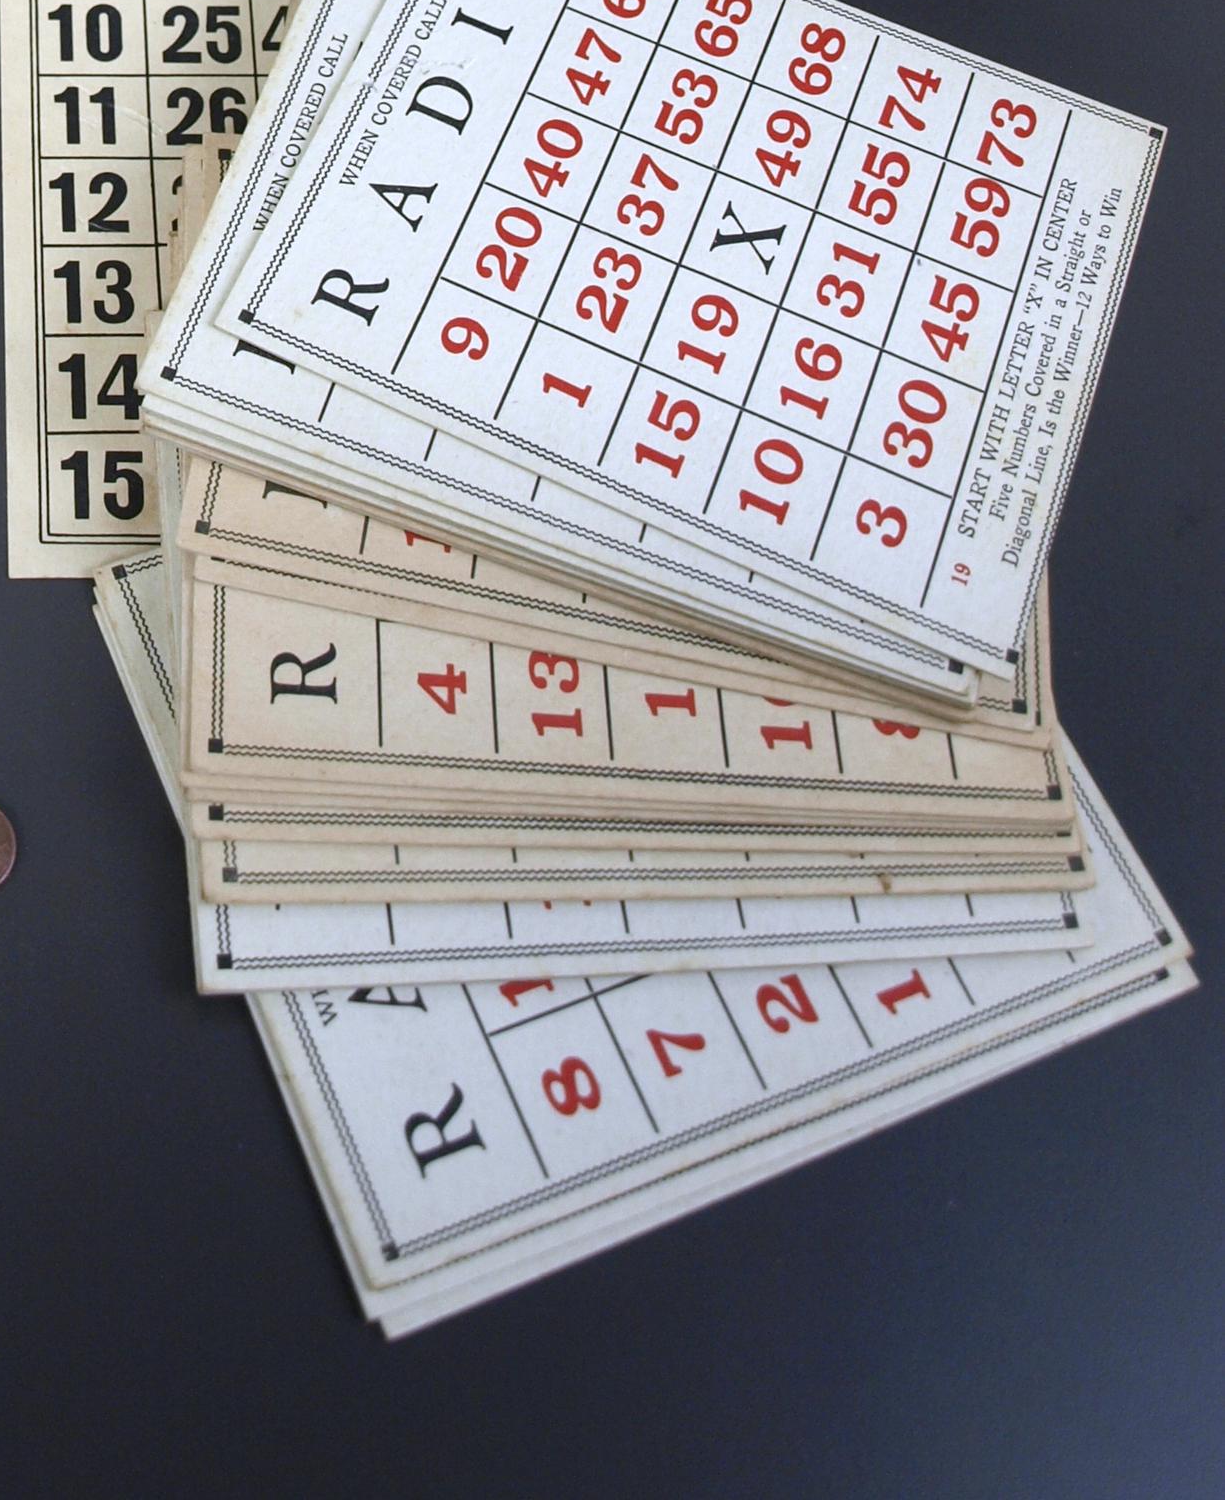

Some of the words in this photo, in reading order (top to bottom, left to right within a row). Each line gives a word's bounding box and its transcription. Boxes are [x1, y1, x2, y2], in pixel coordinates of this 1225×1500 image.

[48, 4, 123, 62] 10
[163, 6, 242, 64] 25
[54, 87, 116, 144] 11
[339, 129, 379, 185] WHEN
[371, 44, 422, 126] COVERED
[414, 0, 447, 40] CALL
[253, 173, 289, 231] WHEN
[281, 82, 326, 167] COVERED
[318, 33, 348, 78] CALL
[49, 172, 130, 233] 12
[441, 317, 489, 360] 9
[476, 207, 542, 292] 20
[523, 119, 583, 198] 40
[566, 28, 622, 106] 47
[1042, 178, 1077, 251] CENTER
[1079, 209, 1091, 226] or
[1099, 188, 1122, 217] Win
[1097, 224, 1111, 239] to
[54, 260, 135, 324] 13
[1034, 256, 1053, 281] IN
[1055, 231, 1086, 293] Straight
[1080, 244, 1107, 285] Ways
[1044, 314, 1062, 330] in
[1055, 299, 1067, 308] a
[998, 321, 1035, 401] LETTER
[1024, 333, 1056, 397] Covered
[979, 404, 1010, 460] WITH
[1038, 421, 1057, 438] Is
[1046, 389, 1065, 415] the
[1001, 403, 1037, 478] Numbers
[1025, 445, 1053, 485] Line,
[61, 451, 144, 520] 15
[957, 467, 991, 538] START
[988, 484, 1014, 522] Five
[1001, 489, 1037, 568] Diagonal
[951, 563, 971, 586] 19
[268, 640, 341, 706] R
[414, 661, 469, 718] 4
[644, 1025, 708, 1080] 7
[539, 1053, 603, 1119] 8
[402, 1082, 487, 1178] R
